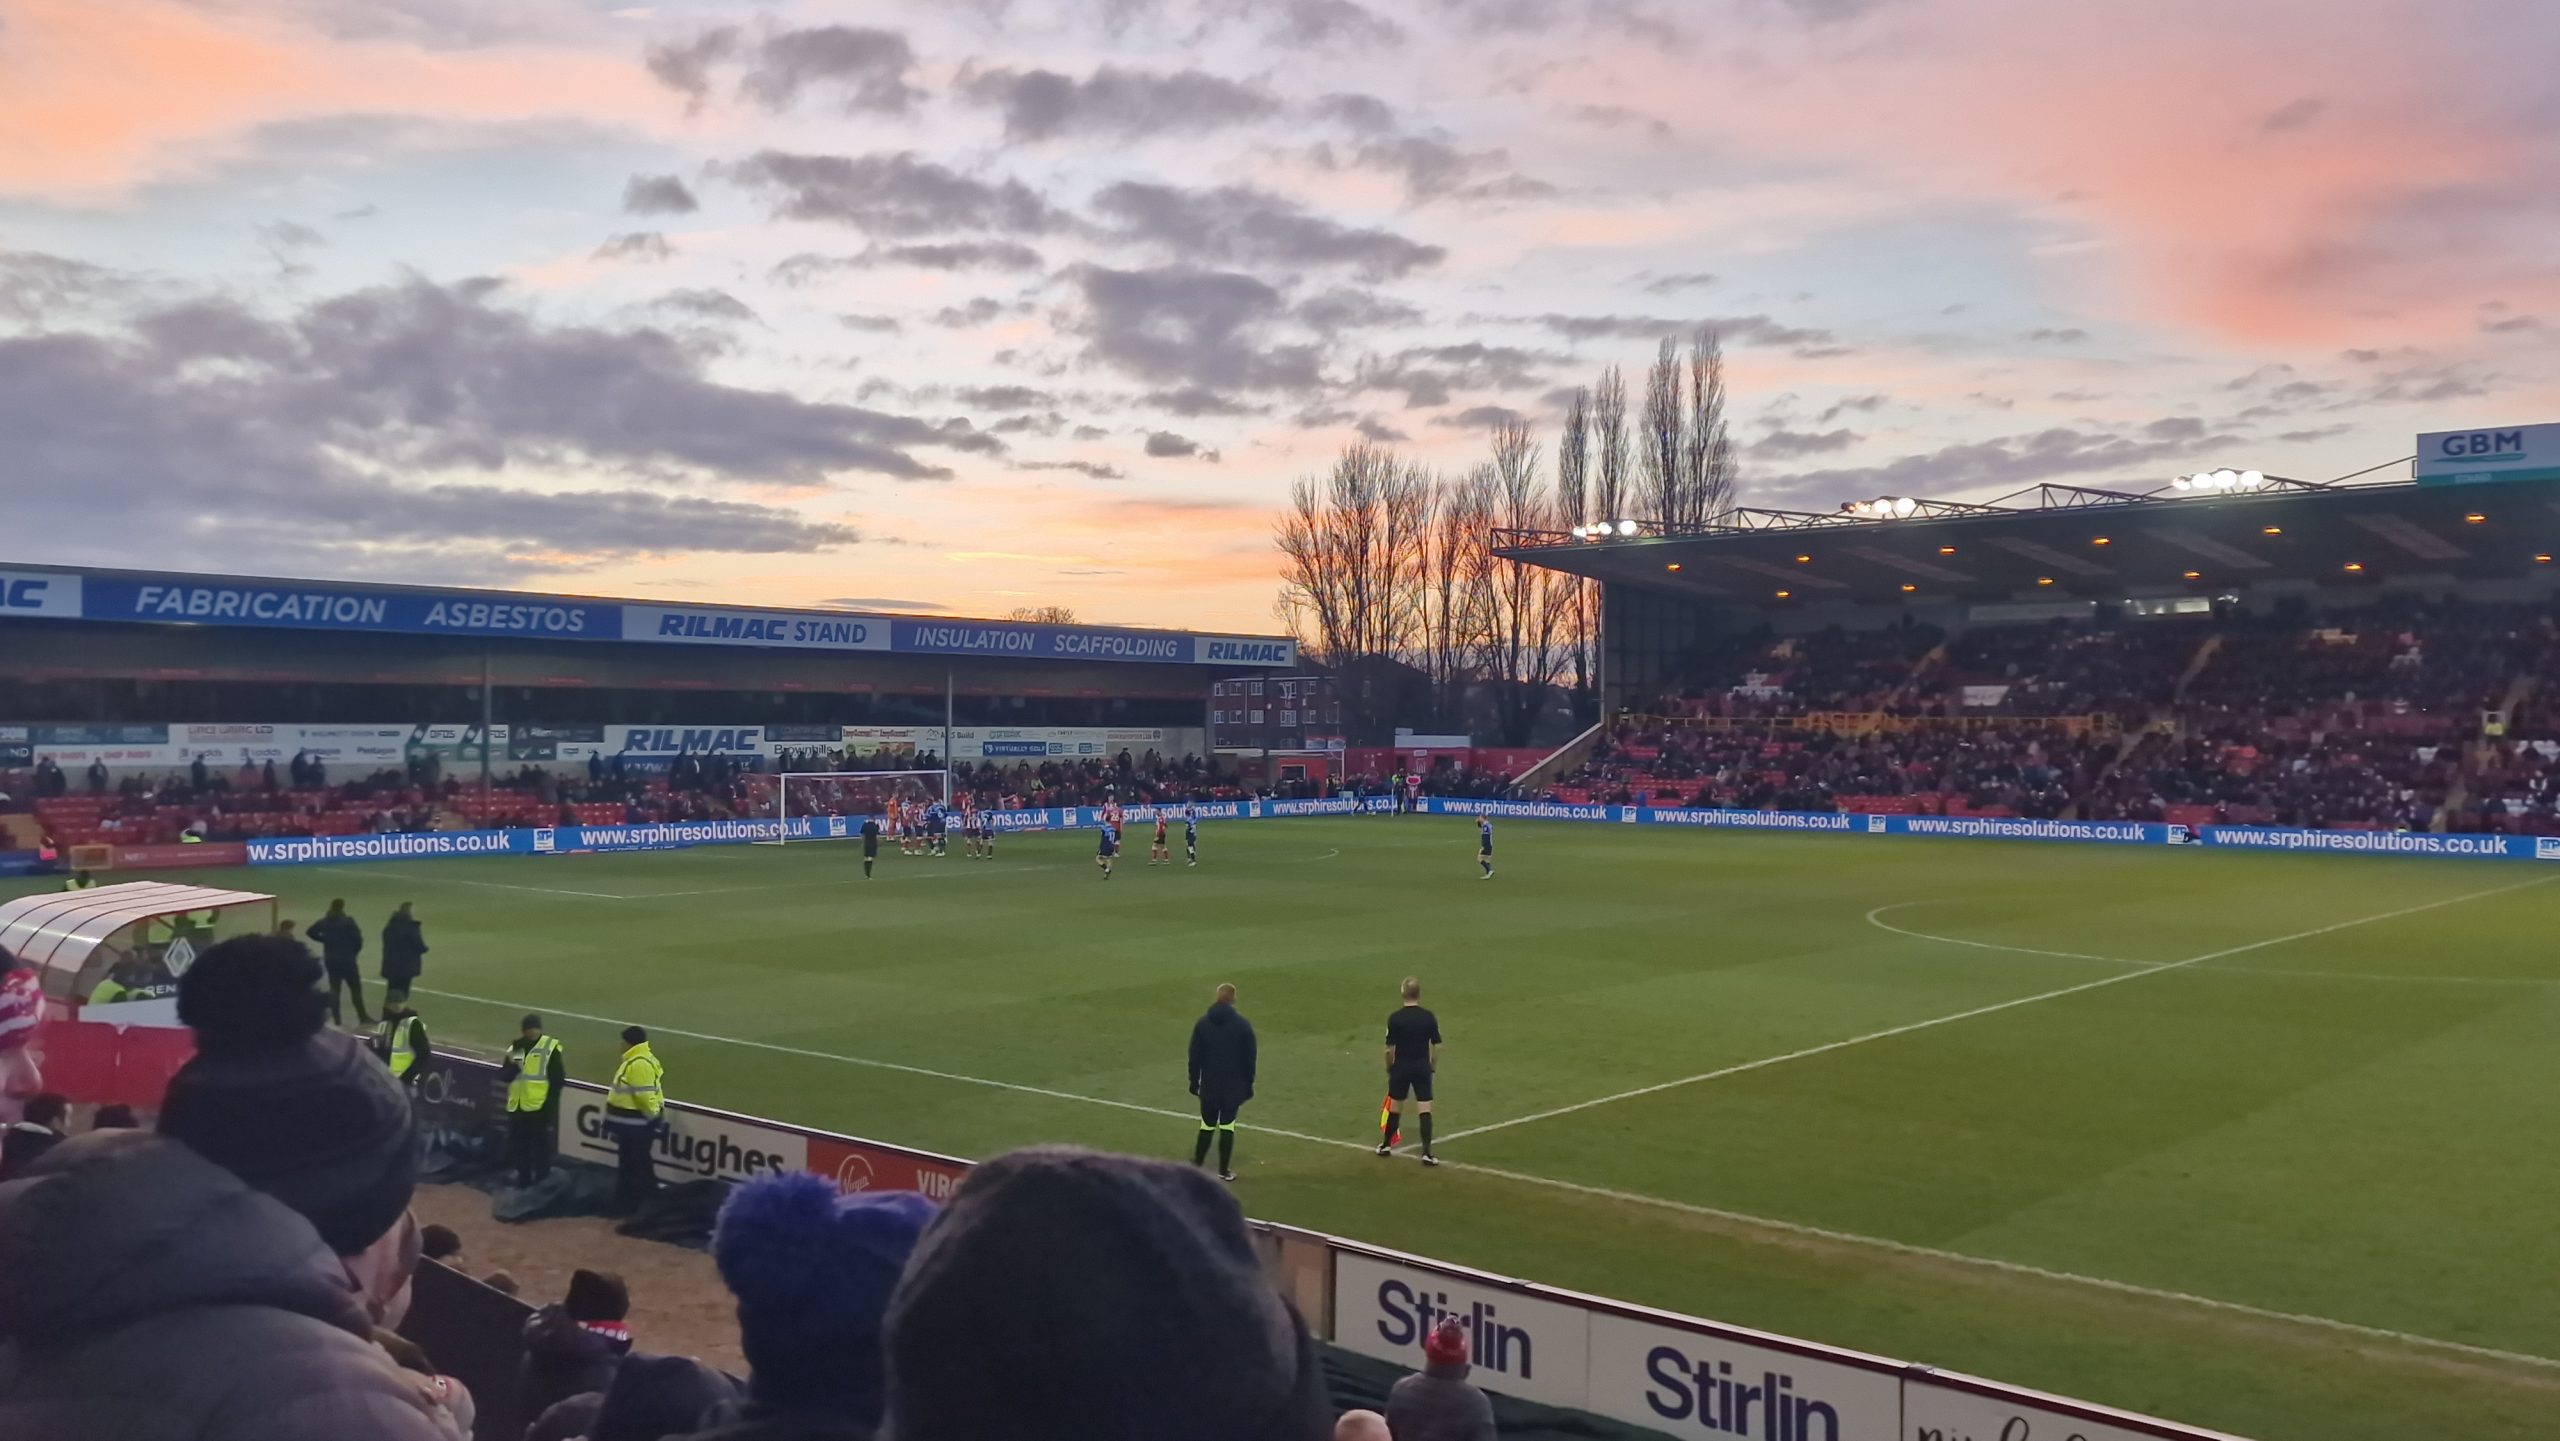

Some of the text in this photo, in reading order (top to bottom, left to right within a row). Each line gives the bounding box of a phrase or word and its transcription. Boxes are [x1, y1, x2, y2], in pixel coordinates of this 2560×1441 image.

[2442, 431, 2522, 456] GBM
[0, 578, 49, 608] C
[135, 586, 386, 623] FABRICATION
[423, 601, 586, 632] ASBESTOS
[659, 614, 866, 644] RILMAC STAND
[914, 626, 1035, 651] INSULATION
[1054, 634, 1177, 657] SCAFFOLDING
[1207, 641, 1287, 662] RILMAC
[624, 729, 759, 751] RILMAC
[774, 744, 833, 755] Bownhills
[1443, 800, 1607, 820] www.srphiresolutions.co.uk
[1654, 809, 1850, 829] www.srphiresolutions.co.uk
[581, 820, 812, 846] www.srphiresolutions.co.uk
[1907, 818, 2145, 840] www.srphiresolutions.co.uk
[2215, 829, 2508, 855] www.srphiresolutions.co.uk
[1377, 1279, 1532, 1380] Stilin
[1646, 1346, 1839, 1441] Stirlin
